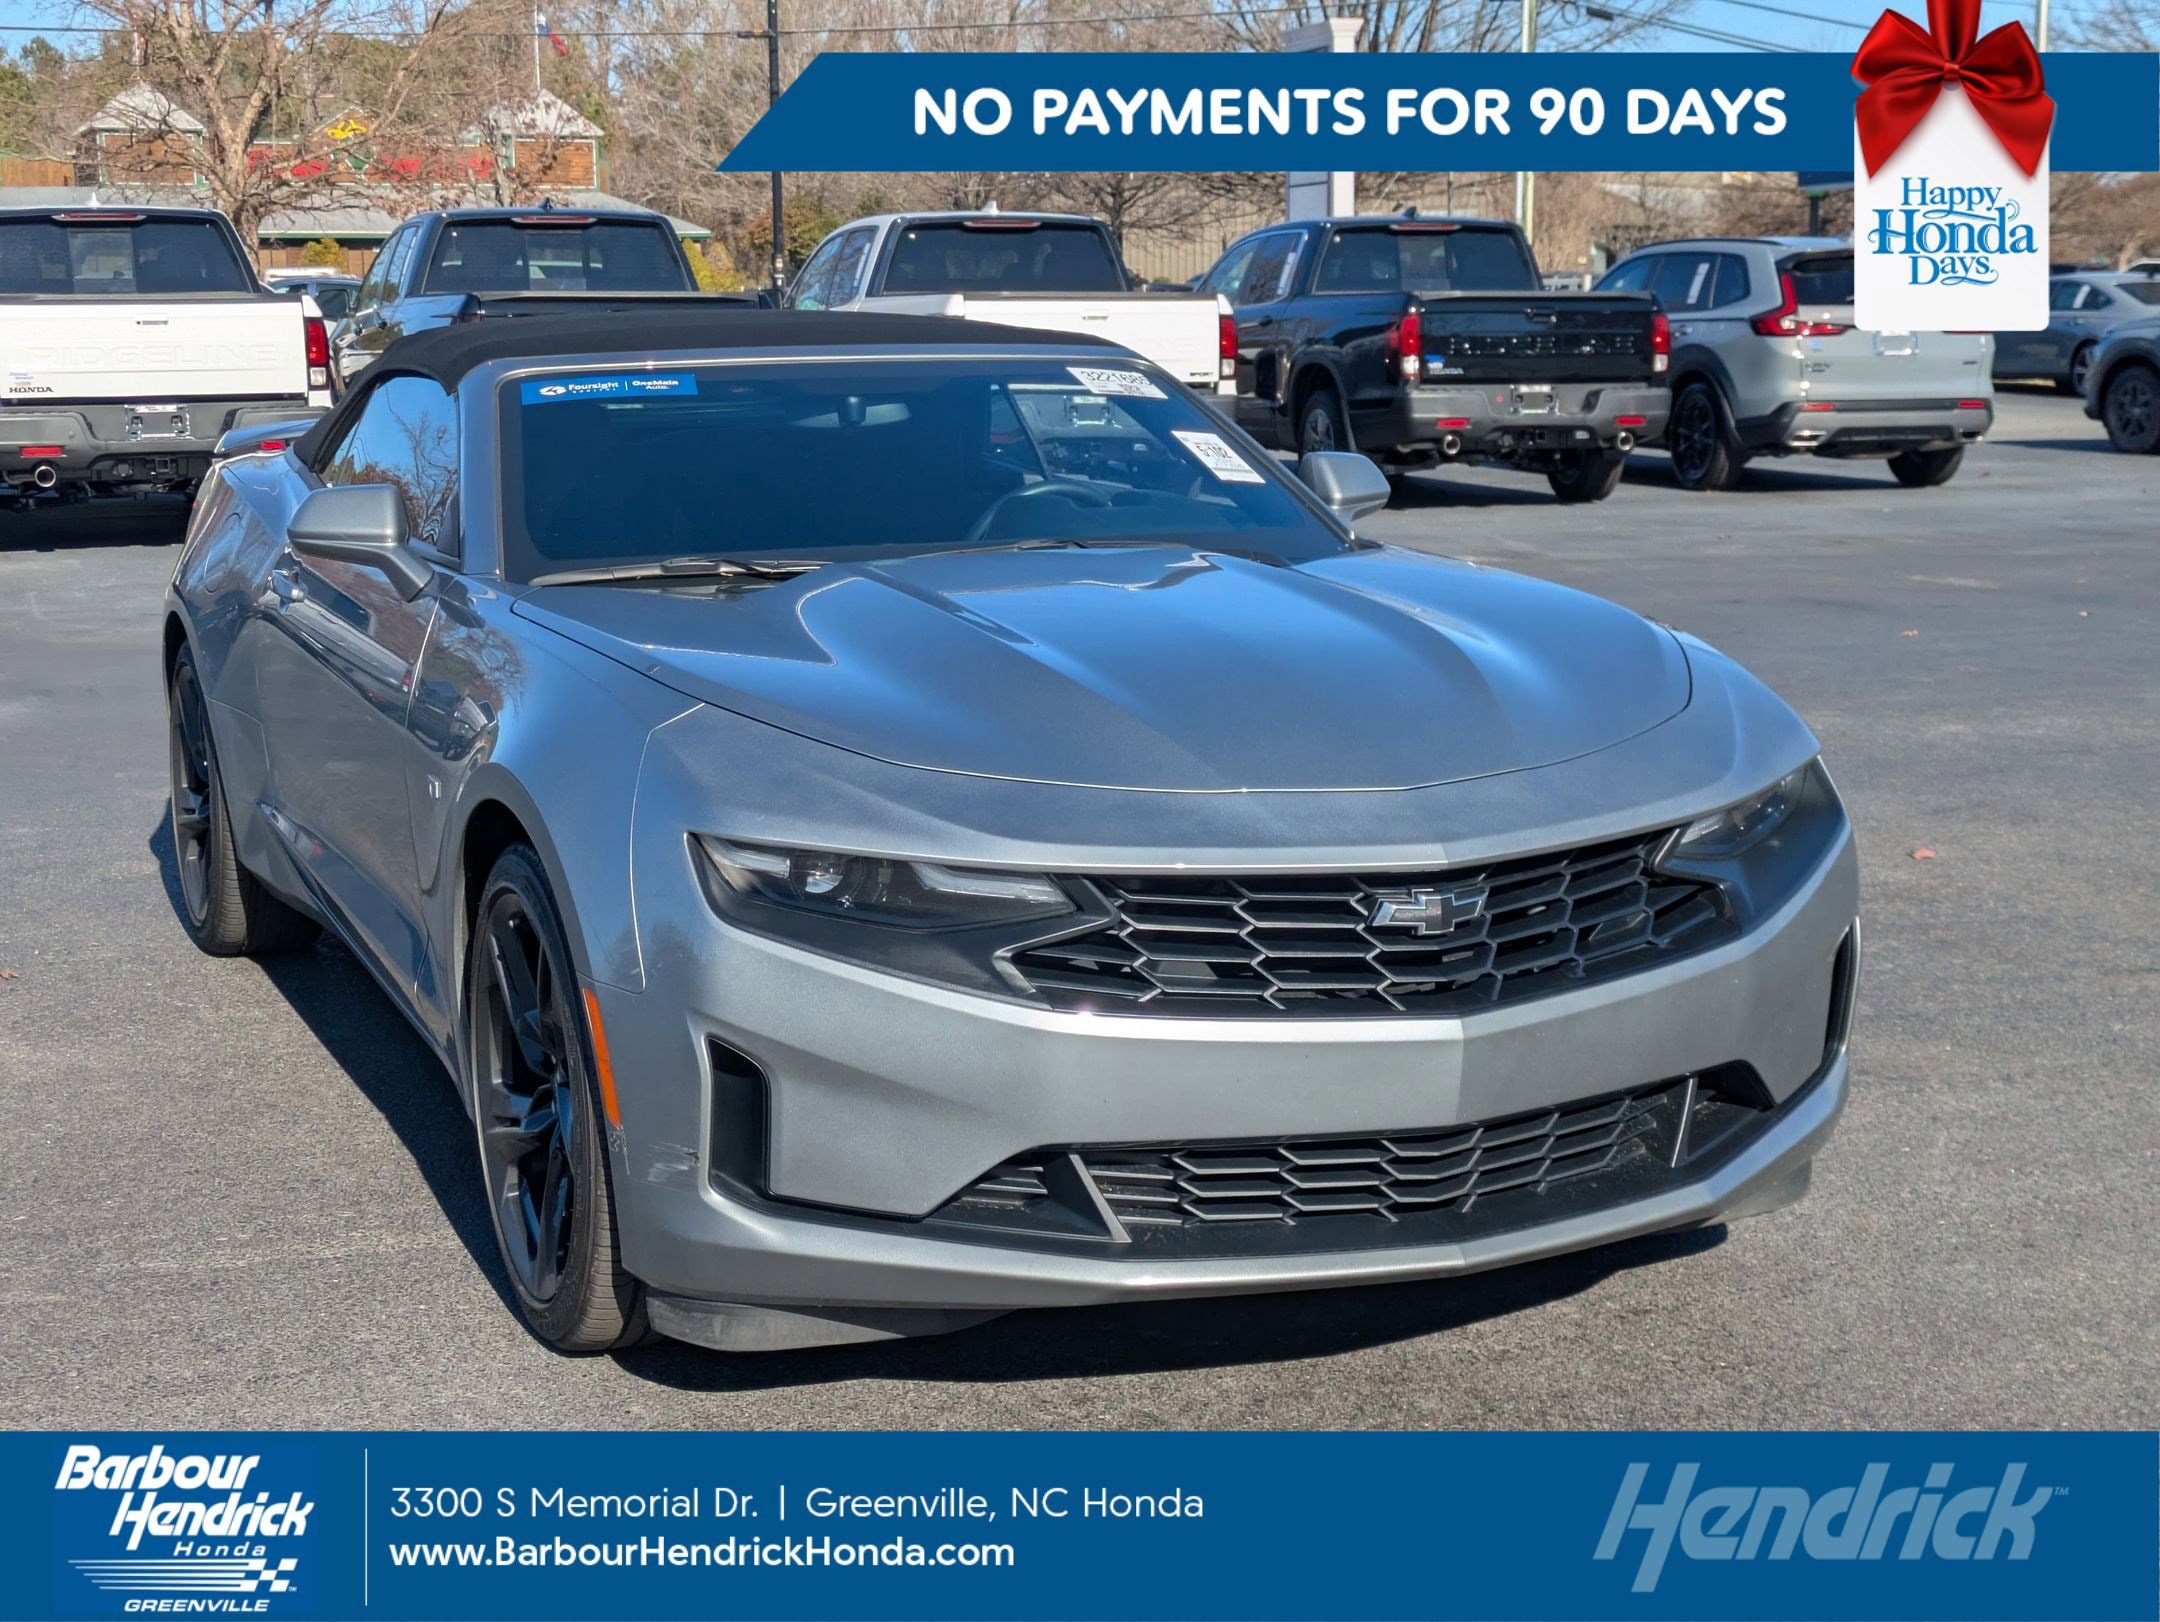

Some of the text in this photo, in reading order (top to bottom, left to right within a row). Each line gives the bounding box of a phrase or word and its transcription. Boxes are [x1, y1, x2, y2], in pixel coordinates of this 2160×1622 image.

[27, 343, 281, 368] RIDGELINE
[568, 381, 619, 391] Foursight
[632, 379, 679, 387] OneMain
